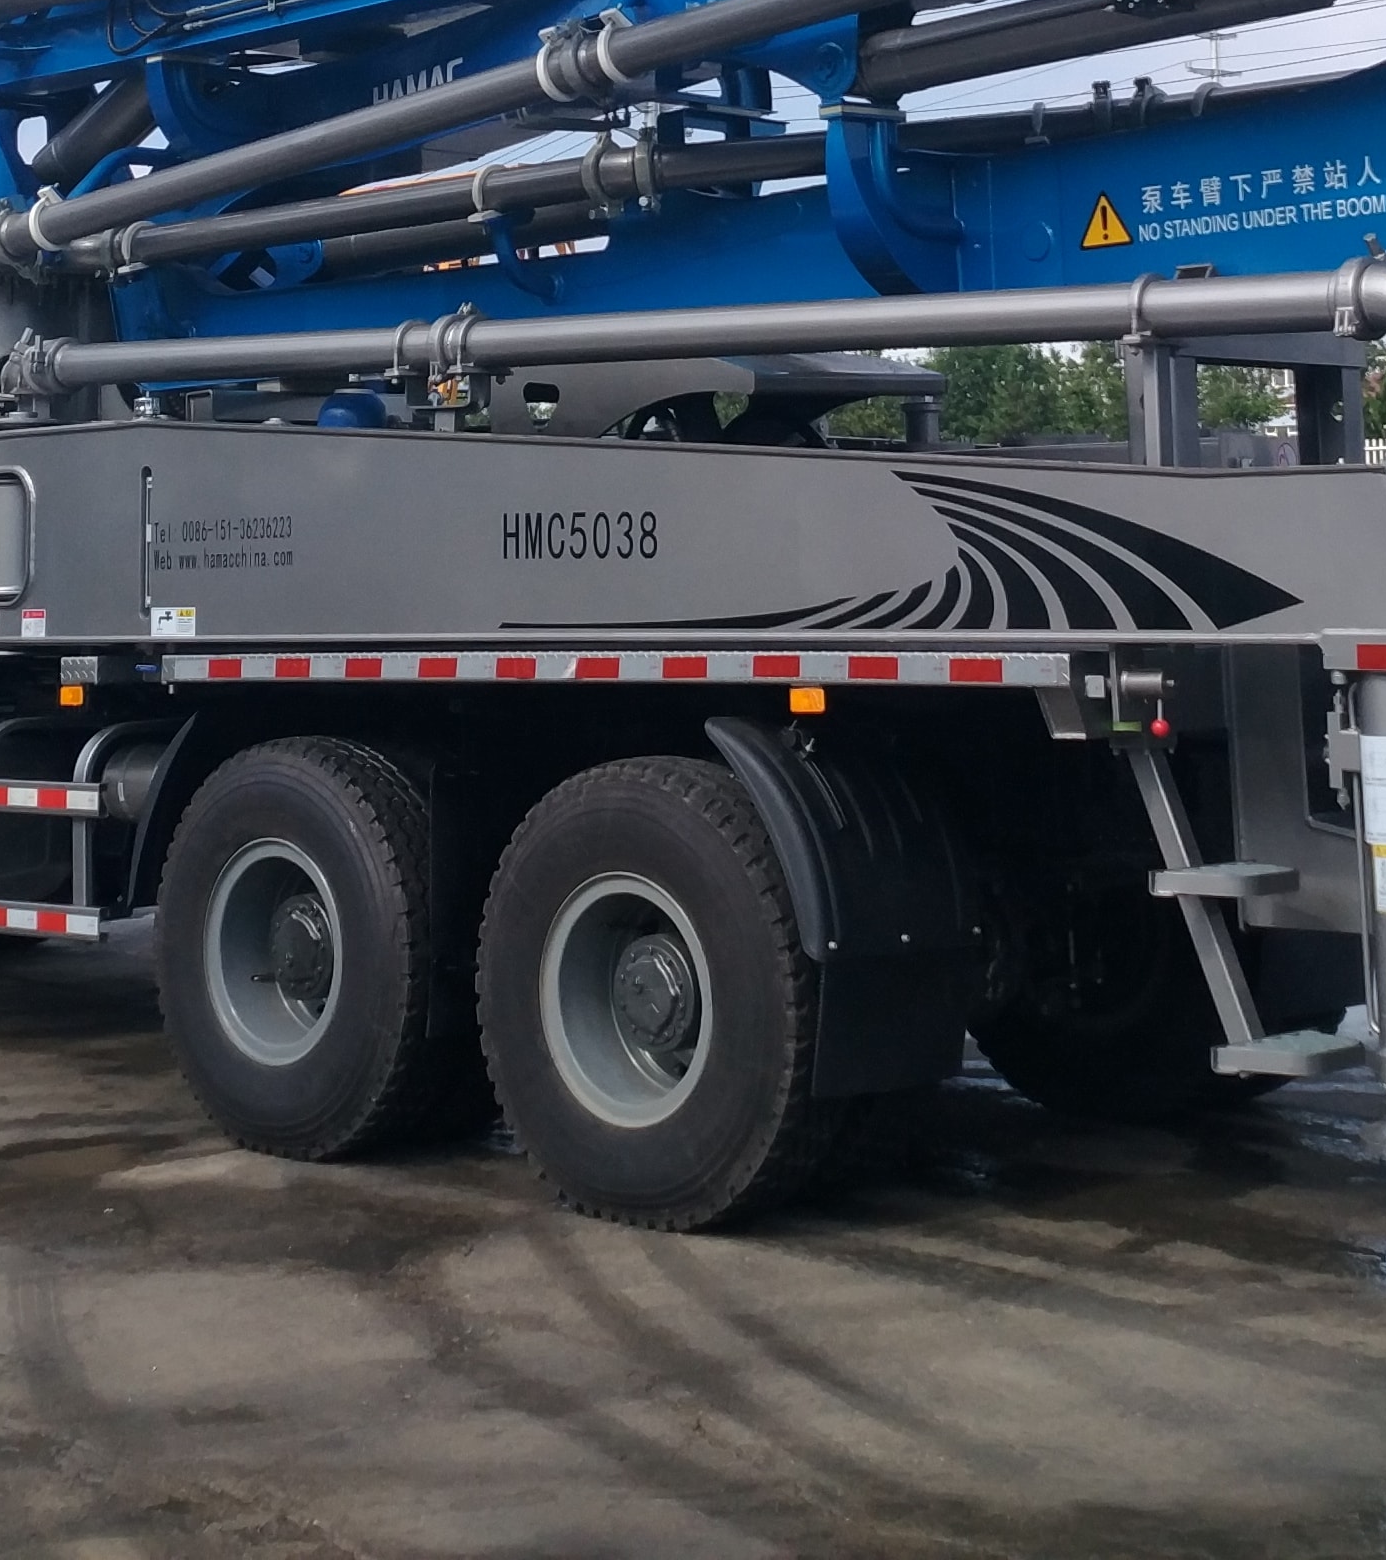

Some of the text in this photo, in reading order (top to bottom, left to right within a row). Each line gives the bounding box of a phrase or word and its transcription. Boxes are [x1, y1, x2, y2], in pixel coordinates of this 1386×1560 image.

[1140, 155, 1382, 215] 泵车臂下严禁站人
[1138, 222, 1161, 243] NO
[1163, 212, 1239, 240] STANDING
[1242, 205, 1298, 230] UNDER
[1299, 200, 1333, 223] THE
[181, 515, 293, 542] 0086-151-36236223
[503, 510, 658, 560] HMC5038
[153, 549, 172, 571] Web
